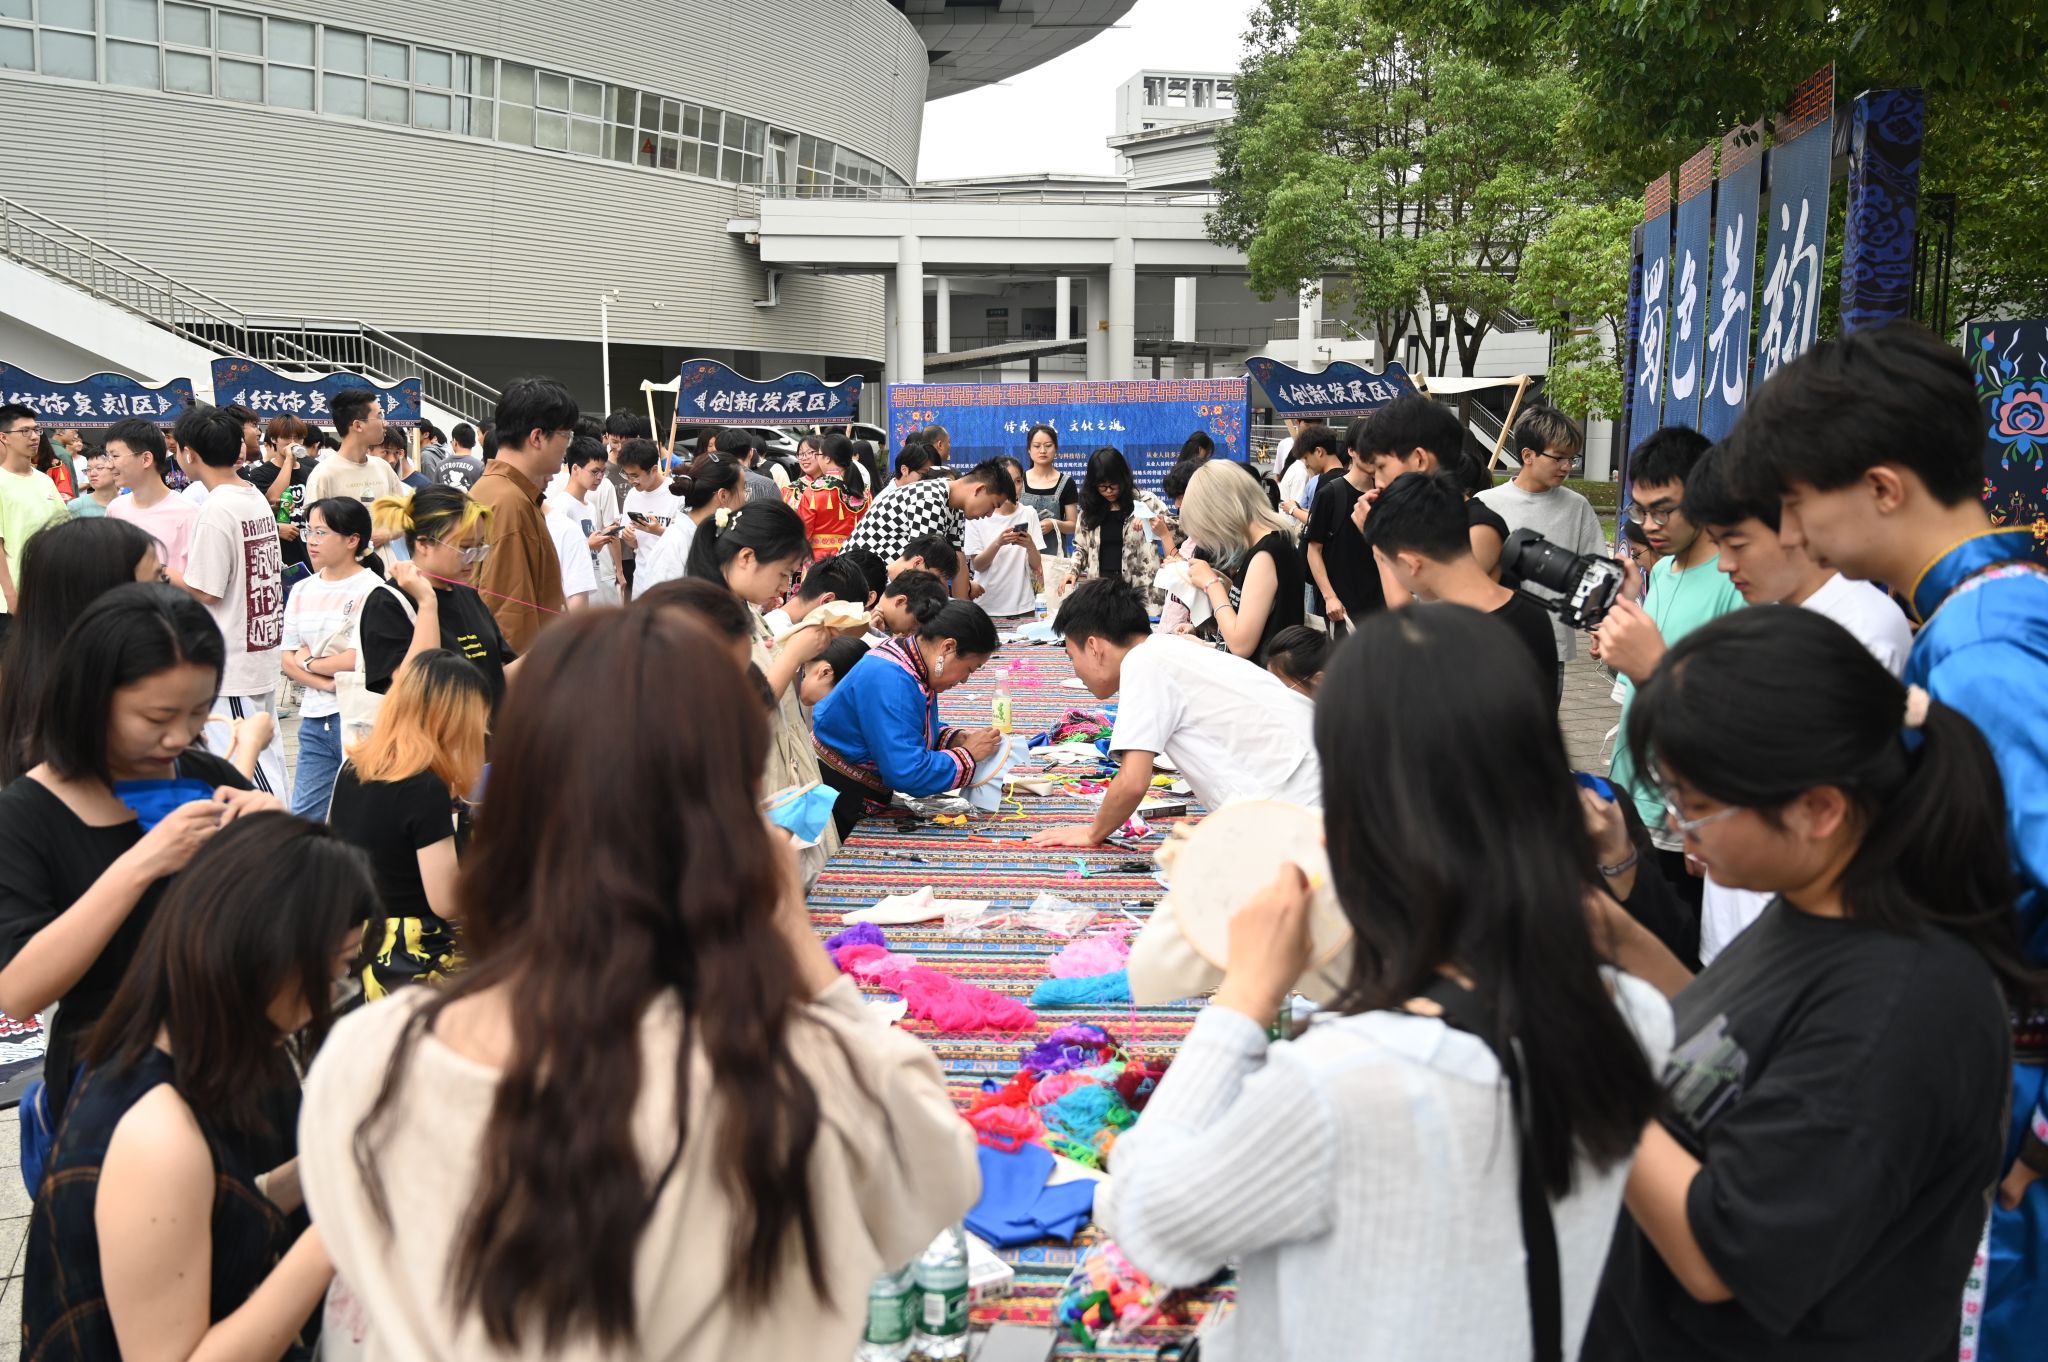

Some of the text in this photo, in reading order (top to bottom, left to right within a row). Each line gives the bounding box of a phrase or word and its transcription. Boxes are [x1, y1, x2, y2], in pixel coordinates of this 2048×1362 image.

[9, 391, 158, 416] 纹饰复刻区
[250, 390, 385, 414] 纹饰复
[709, 390, 827, 413] 创新发展区
[1290, 380, 1392, 405] 创新发展区
[1004, 418, 1126, 433] 传承美 文化之魂
